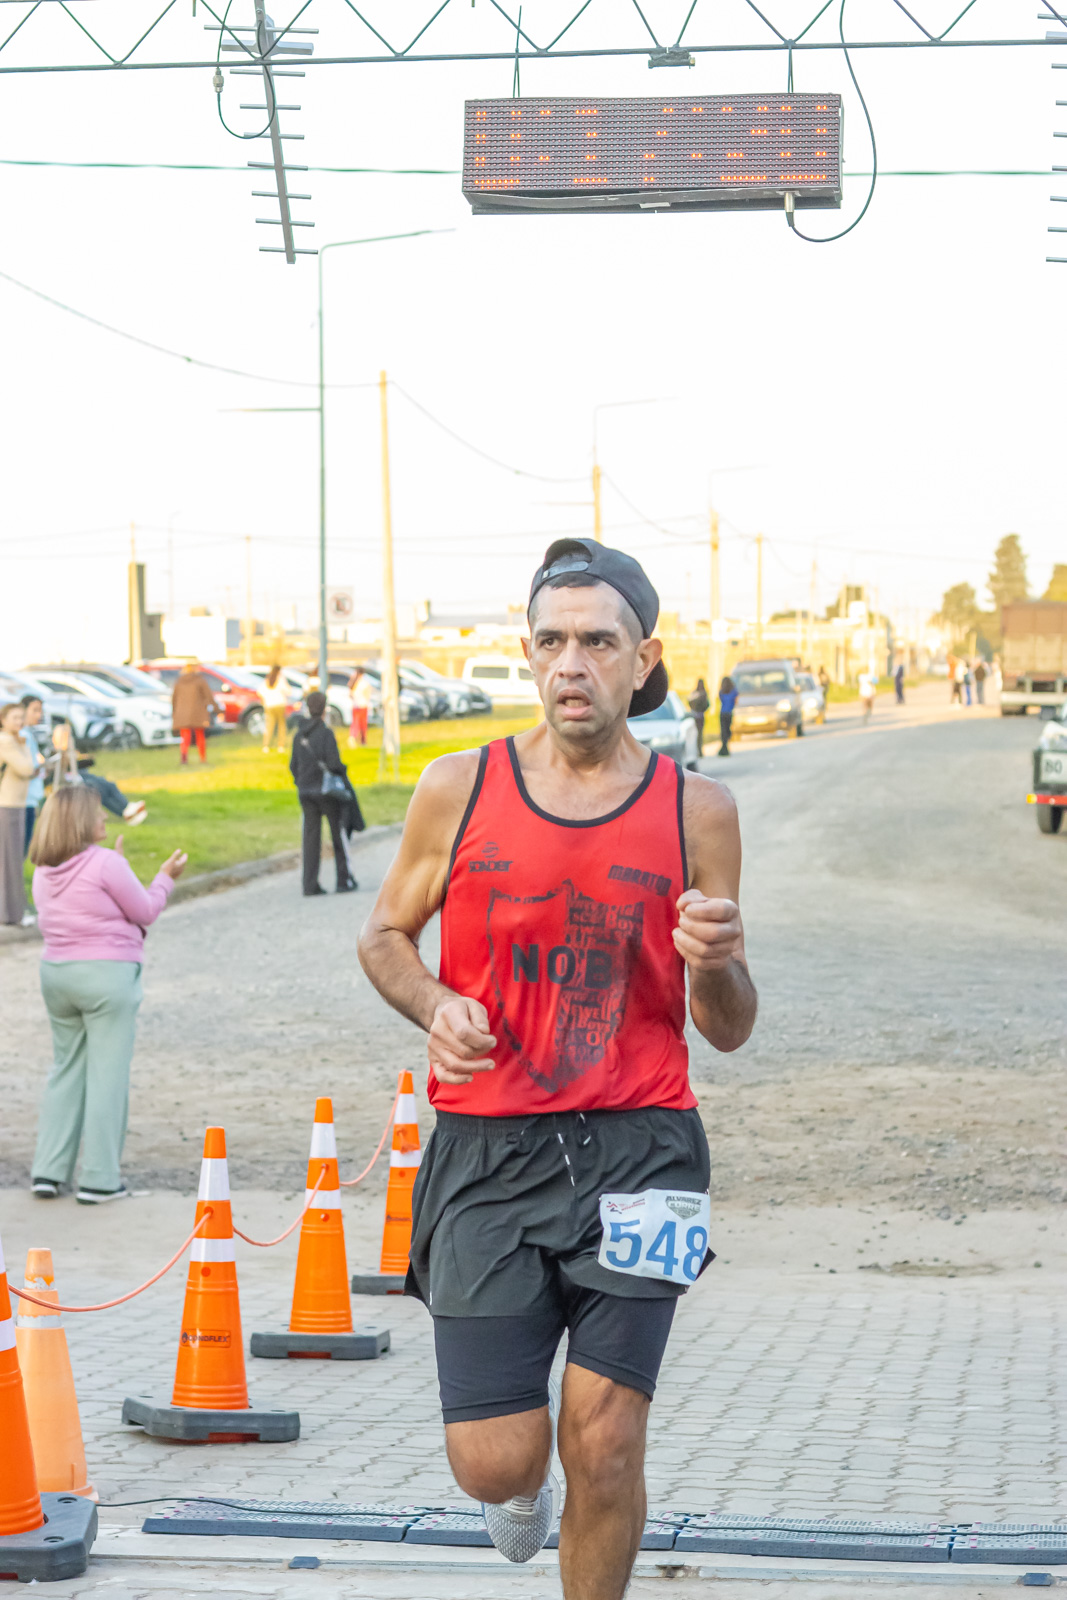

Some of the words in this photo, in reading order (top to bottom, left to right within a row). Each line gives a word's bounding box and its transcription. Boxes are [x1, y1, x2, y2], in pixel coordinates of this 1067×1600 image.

[665, 1195, 702, 1206] ALVAREZ
[668, 1201, 701, 1212] CORRE
[606, 1219, 707, 1281] 548
